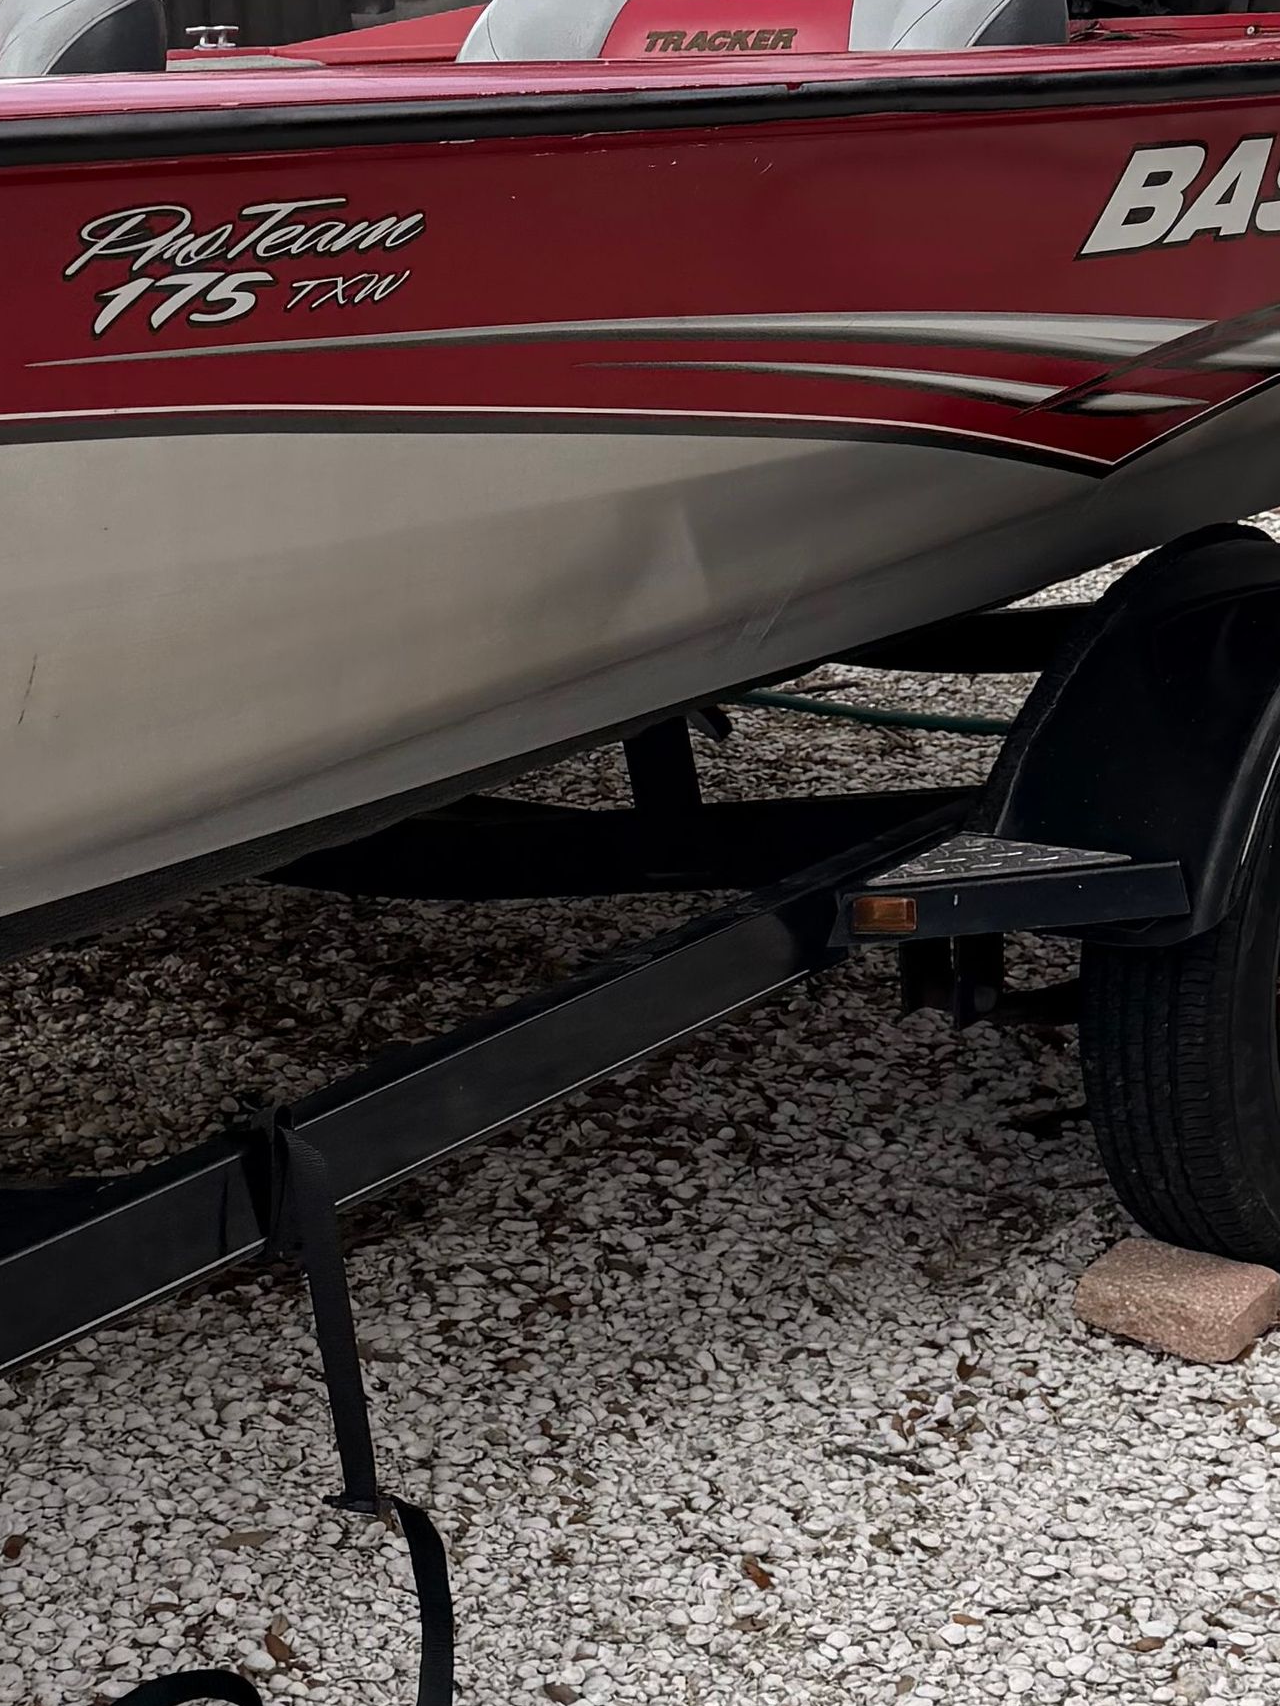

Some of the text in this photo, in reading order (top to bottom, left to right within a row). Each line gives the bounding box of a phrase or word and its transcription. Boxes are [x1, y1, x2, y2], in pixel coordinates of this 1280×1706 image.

[644, 28, 798, 53] TRACKER
[92, 269, 411, 335] 175 TXW
